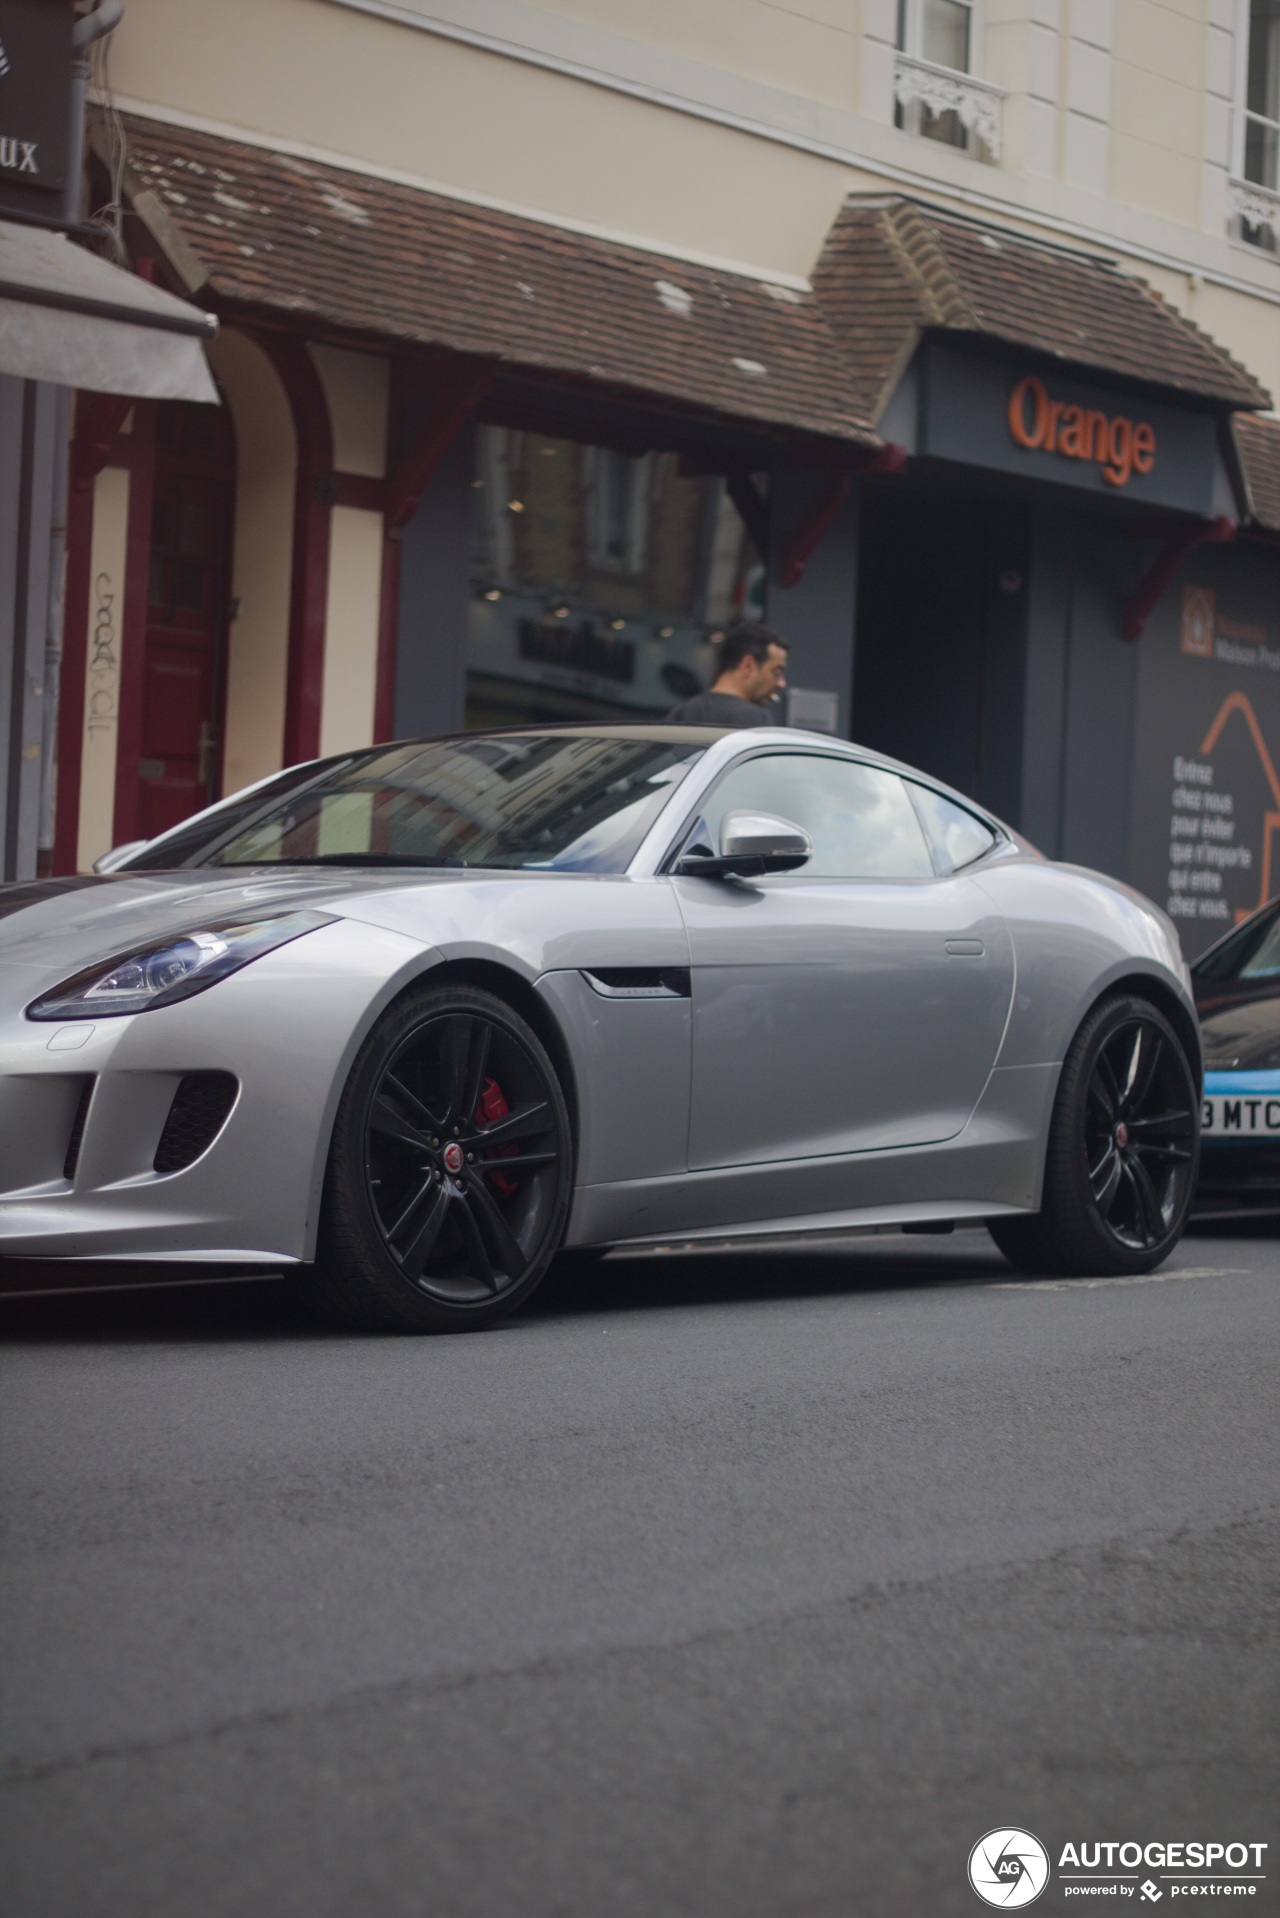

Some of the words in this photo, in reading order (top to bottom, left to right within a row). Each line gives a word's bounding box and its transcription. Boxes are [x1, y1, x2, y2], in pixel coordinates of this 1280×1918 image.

[0, 135, 39, 173] ux
[1008, 376, 1156, 486] Orange
[1173, 755, 1214, 785] Entrez
[1171, 785, 1201, 811] chez
[1203, 791, 1234, 815] nous
[1170, 814, 1200, 840] pour
[1201, 814, 1236, 841] éviter
[1169, 841, 1193, 867] que
[1196, 843, 1252, 870] n'importe
[1168, 866, 1189, 892] qui
[1190, 870, 1223, 894] entre
[1166, 893, 1197, 918] chez
[1224, 1101, 1280, 1129] MTC
